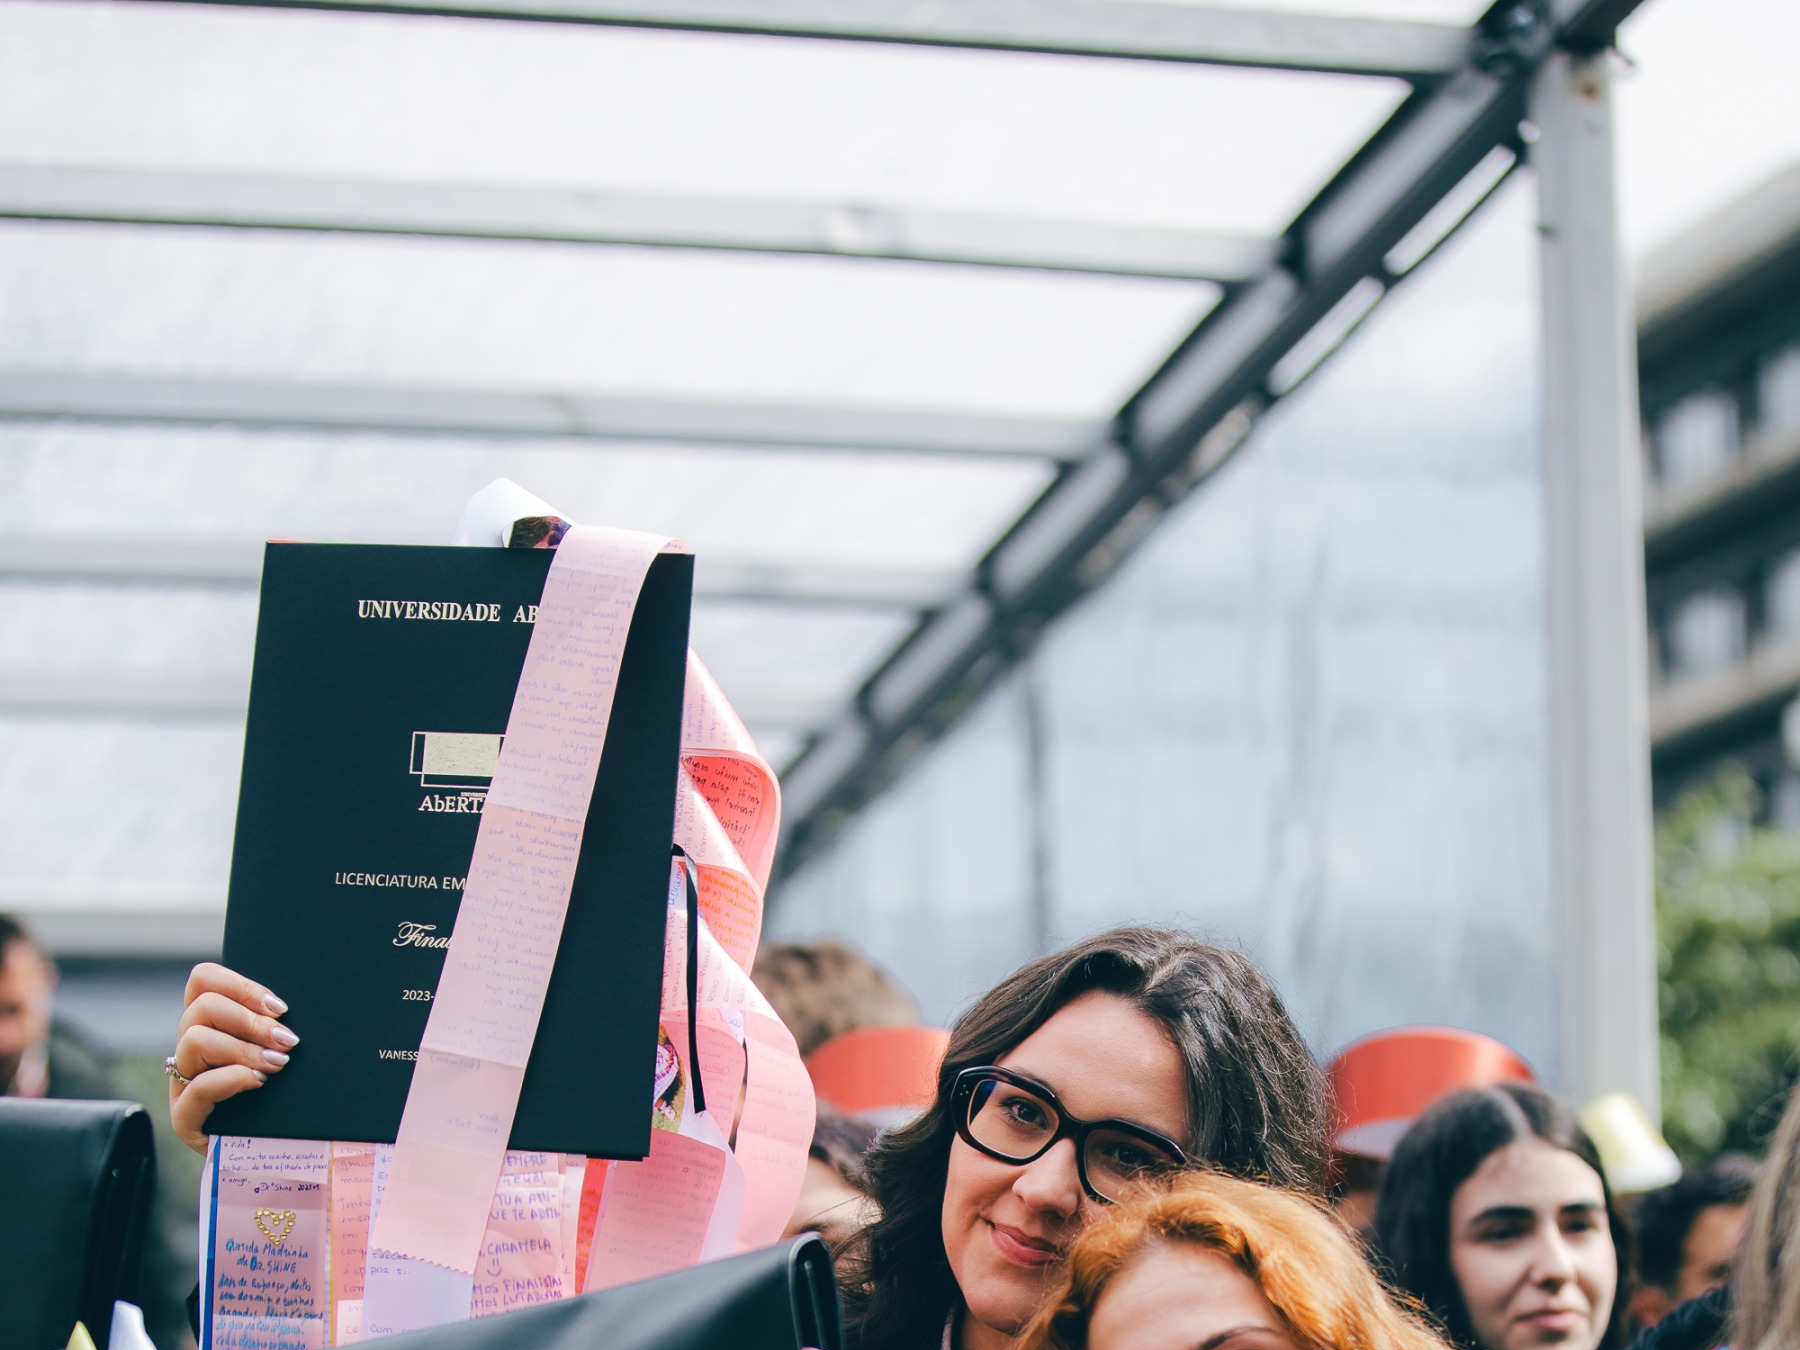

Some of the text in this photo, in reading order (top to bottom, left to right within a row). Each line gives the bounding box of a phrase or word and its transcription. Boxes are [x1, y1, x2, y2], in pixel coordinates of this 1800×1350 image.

[358, 599, 539, 624] UNIVERSIDADE AB
[418, 795, 484, 814] AbERT
[335, 872, 466, 890] LICENCIATURA EM
[402, 989, 435, 1002] 2023-
[378, 1049, 420, 1062] VANESS
[505, 1153, 548, 1169] EMPRE
[225, 1239, 309, 1259] Querida Madrinha
[487, 1238, 552, 1256] CARAMELA
